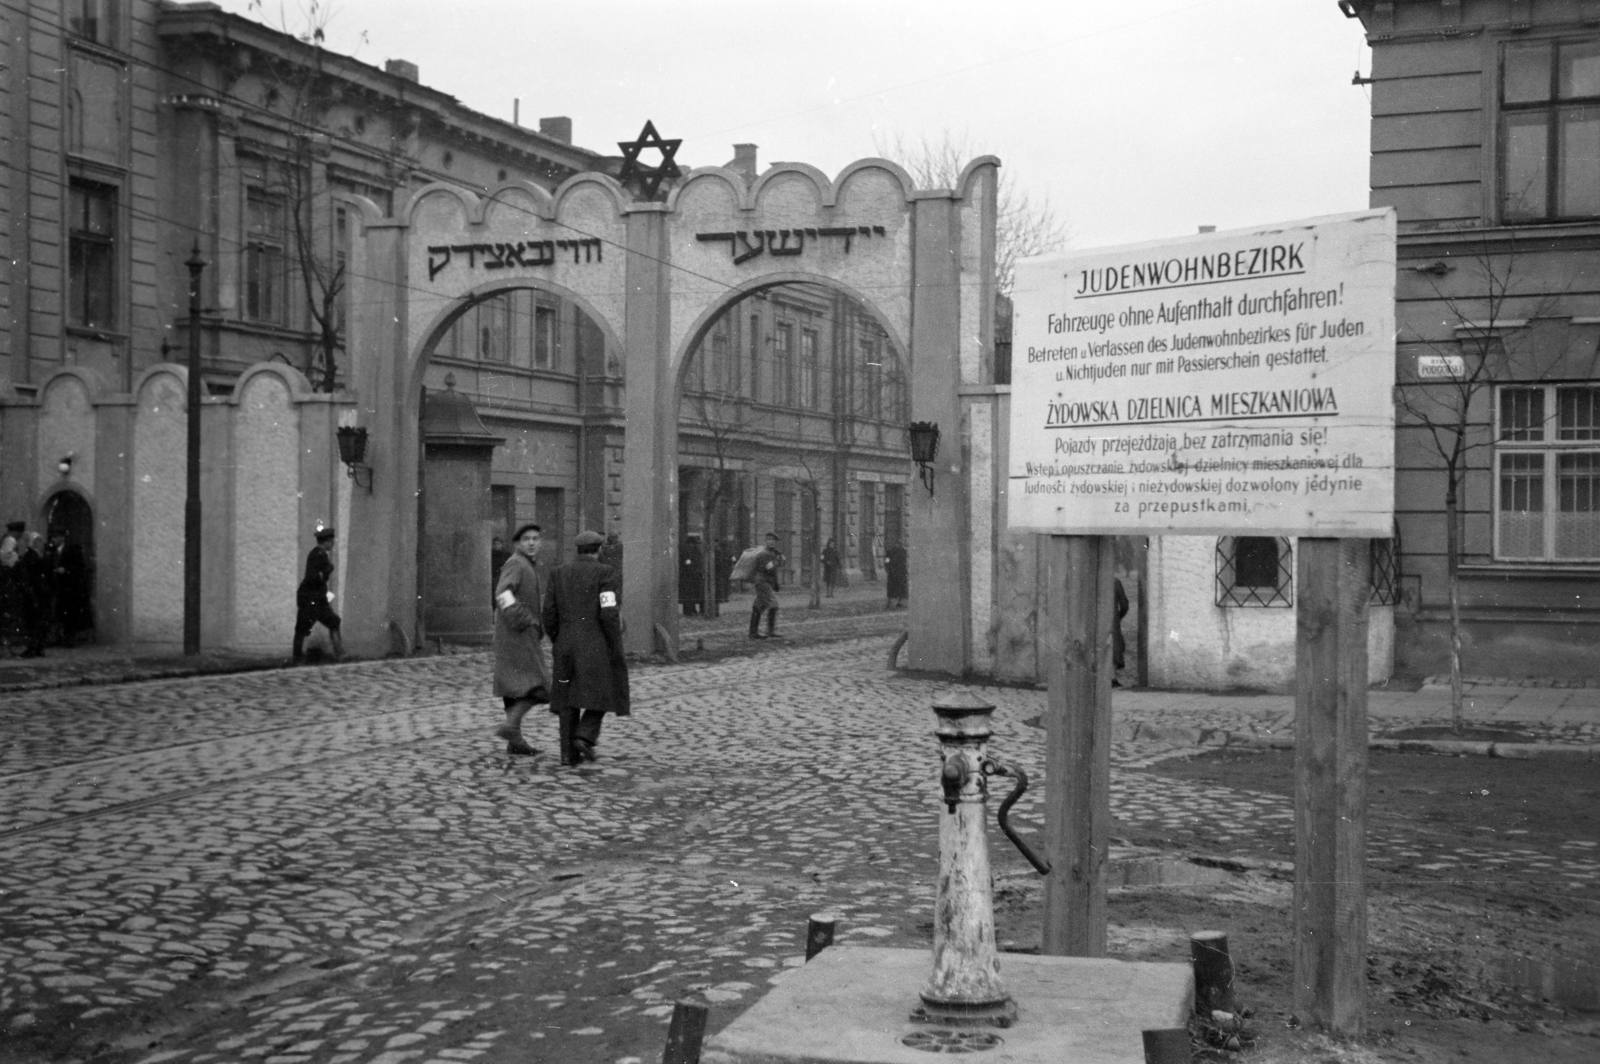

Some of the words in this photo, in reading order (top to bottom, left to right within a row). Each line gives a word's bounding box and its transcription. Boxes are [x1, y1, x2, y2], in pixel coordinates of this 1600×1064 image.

[696, 226, 885, 265] יידישער
[1077, 243, 1304, 294] JUDENWOHNBEZIRK
[1048, 312, 1115, 335] Fahrzeuge
[1119, 305, 1154, 327] ohne
[1156, 296, 1233, 325] Aufenthalt
[1238, 282, 1344, 316] durchfahren!
[1028, 346, 1078, 363] Betreten
[1147, 336, 1168, 353] des
[1170, 325, 1291, 351] Judenwohnbezirkes
[1296, 322, 1317, 343] für
[1320, 318, 1364, 338] Juden
[1131, 362, 1152, 376] nur
[1156, 358, 1174, 373] mit
[1178, 351, 1260, 373] Passierschein
[1266, 346, 1329, 370] gestattet.
[1046, 399, 1119, 425] ŻYDOWSKA
[1127, 395, 1202, 421] DZIELNICA
[1211, 387, 1338, 416] MIESZKANIOWA
[1055, 435, 1097, 454] Pojazdy
[1183, 432, 1206, 450] bez
[1211, 428, 1293, 451] zatrzymania
[1300, 427, 1328, 447] się!
[1061, 462, 1124, 478] opuszczanie
[1129, 459, 1188, 476] żydowskiej
[1195, 456, 1248, 474] dzielnicy
[1252, 453, 1339, 473] mieszkaniowej
[1342, 453, 1363, 469] dla
[1070, 479, 1127, 497] żydowskiej
[1131, 482, 1136, 493] i
[1139, 478, 1222, 496] nieżydowskiej
[1226, 476, 1299, 495] dozwolony
[1305, 476, 1362, 496] jedynie
[1114, 501, 1130, 513] za
